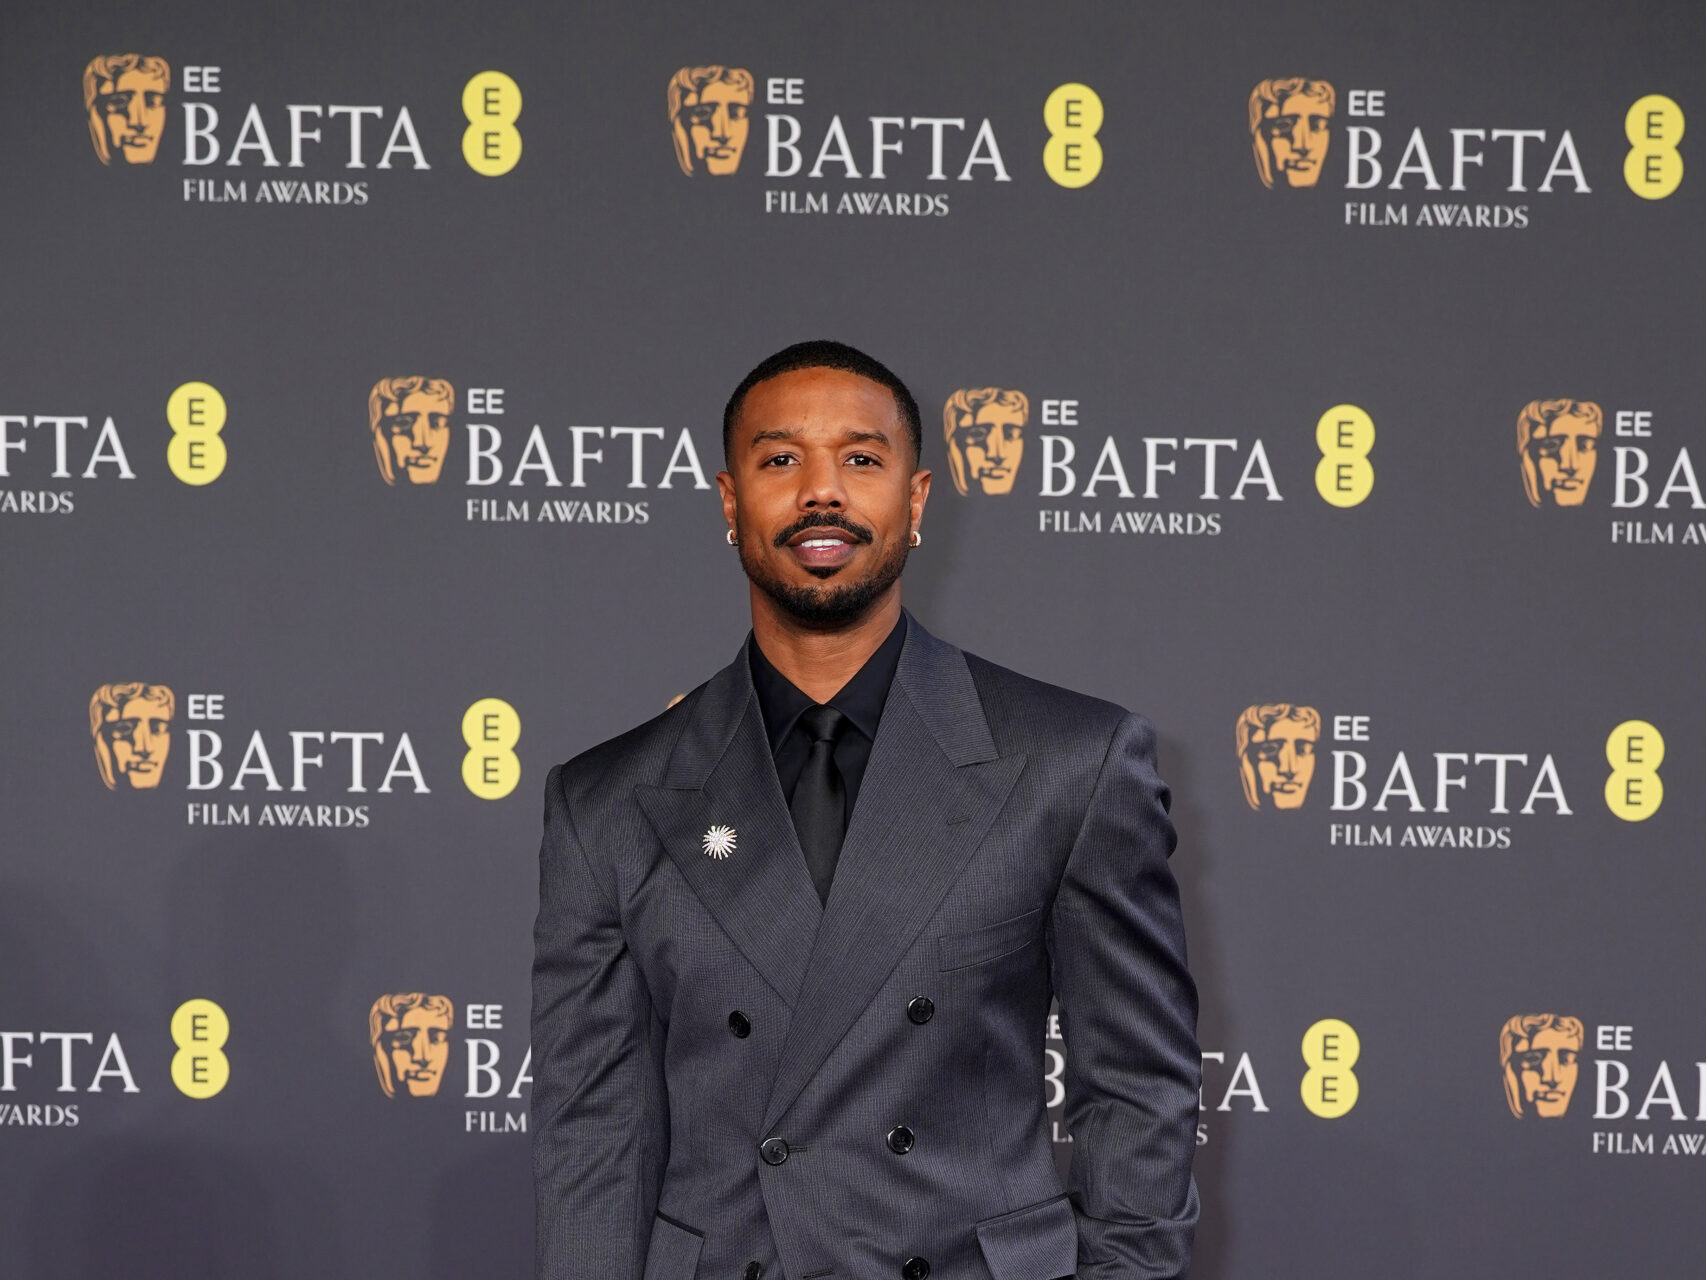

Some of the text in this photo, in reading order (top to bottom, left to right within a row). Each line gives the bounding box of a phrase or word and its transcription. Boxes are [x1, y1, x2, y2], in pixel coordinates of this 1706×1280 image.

[183, 65, 221, 93] EE
[766, 77, 804, 105] EE
[1348, 89, 1386, 117] EE
[182, 102, 431, 170] BAFTA
[765, 114, 1012, 182] BAFTA
[1345, 126, 1591, 194] BAFTA
[183, 178, 369, 205] FILM AWARDS
[765, 190, 949, 216] FILM AWARDS
[1345, 202, 1529, 228] FILM AWARDS
[467, 387, 505, 415] EE
[1041, 399, 1079, 426] EE
[1615, 410, 1653, 438] EE
[465, 423, 711, 490] BAFTA
[1038, 434, 1284, 502] BAFTA
[0, 490, 75, 514] ARDS
[466, 498, 650, 524] FILM AWARDS
[1039, 509, 1222, 536] FILM AWARDS
[1611, 521, 1674, 545] FILM
[187, 693, 225, 721] EE
[1333, 715, 1371, 742] EE
[186, 729, 432, 794] BAFTA
[1329, 750, 1574, 816] BAFTA
[187, 802, 370, 828] FILM AWARDS
[1330, 823, 1511, 849] FILM AWARDS
[466, 1003, 503, 1030] EE
[1596, 1025, 1634, 1051] EE
[465, 1110, 527, 1133] FILM
[1592, 1131, 1654, 1155] FILM
